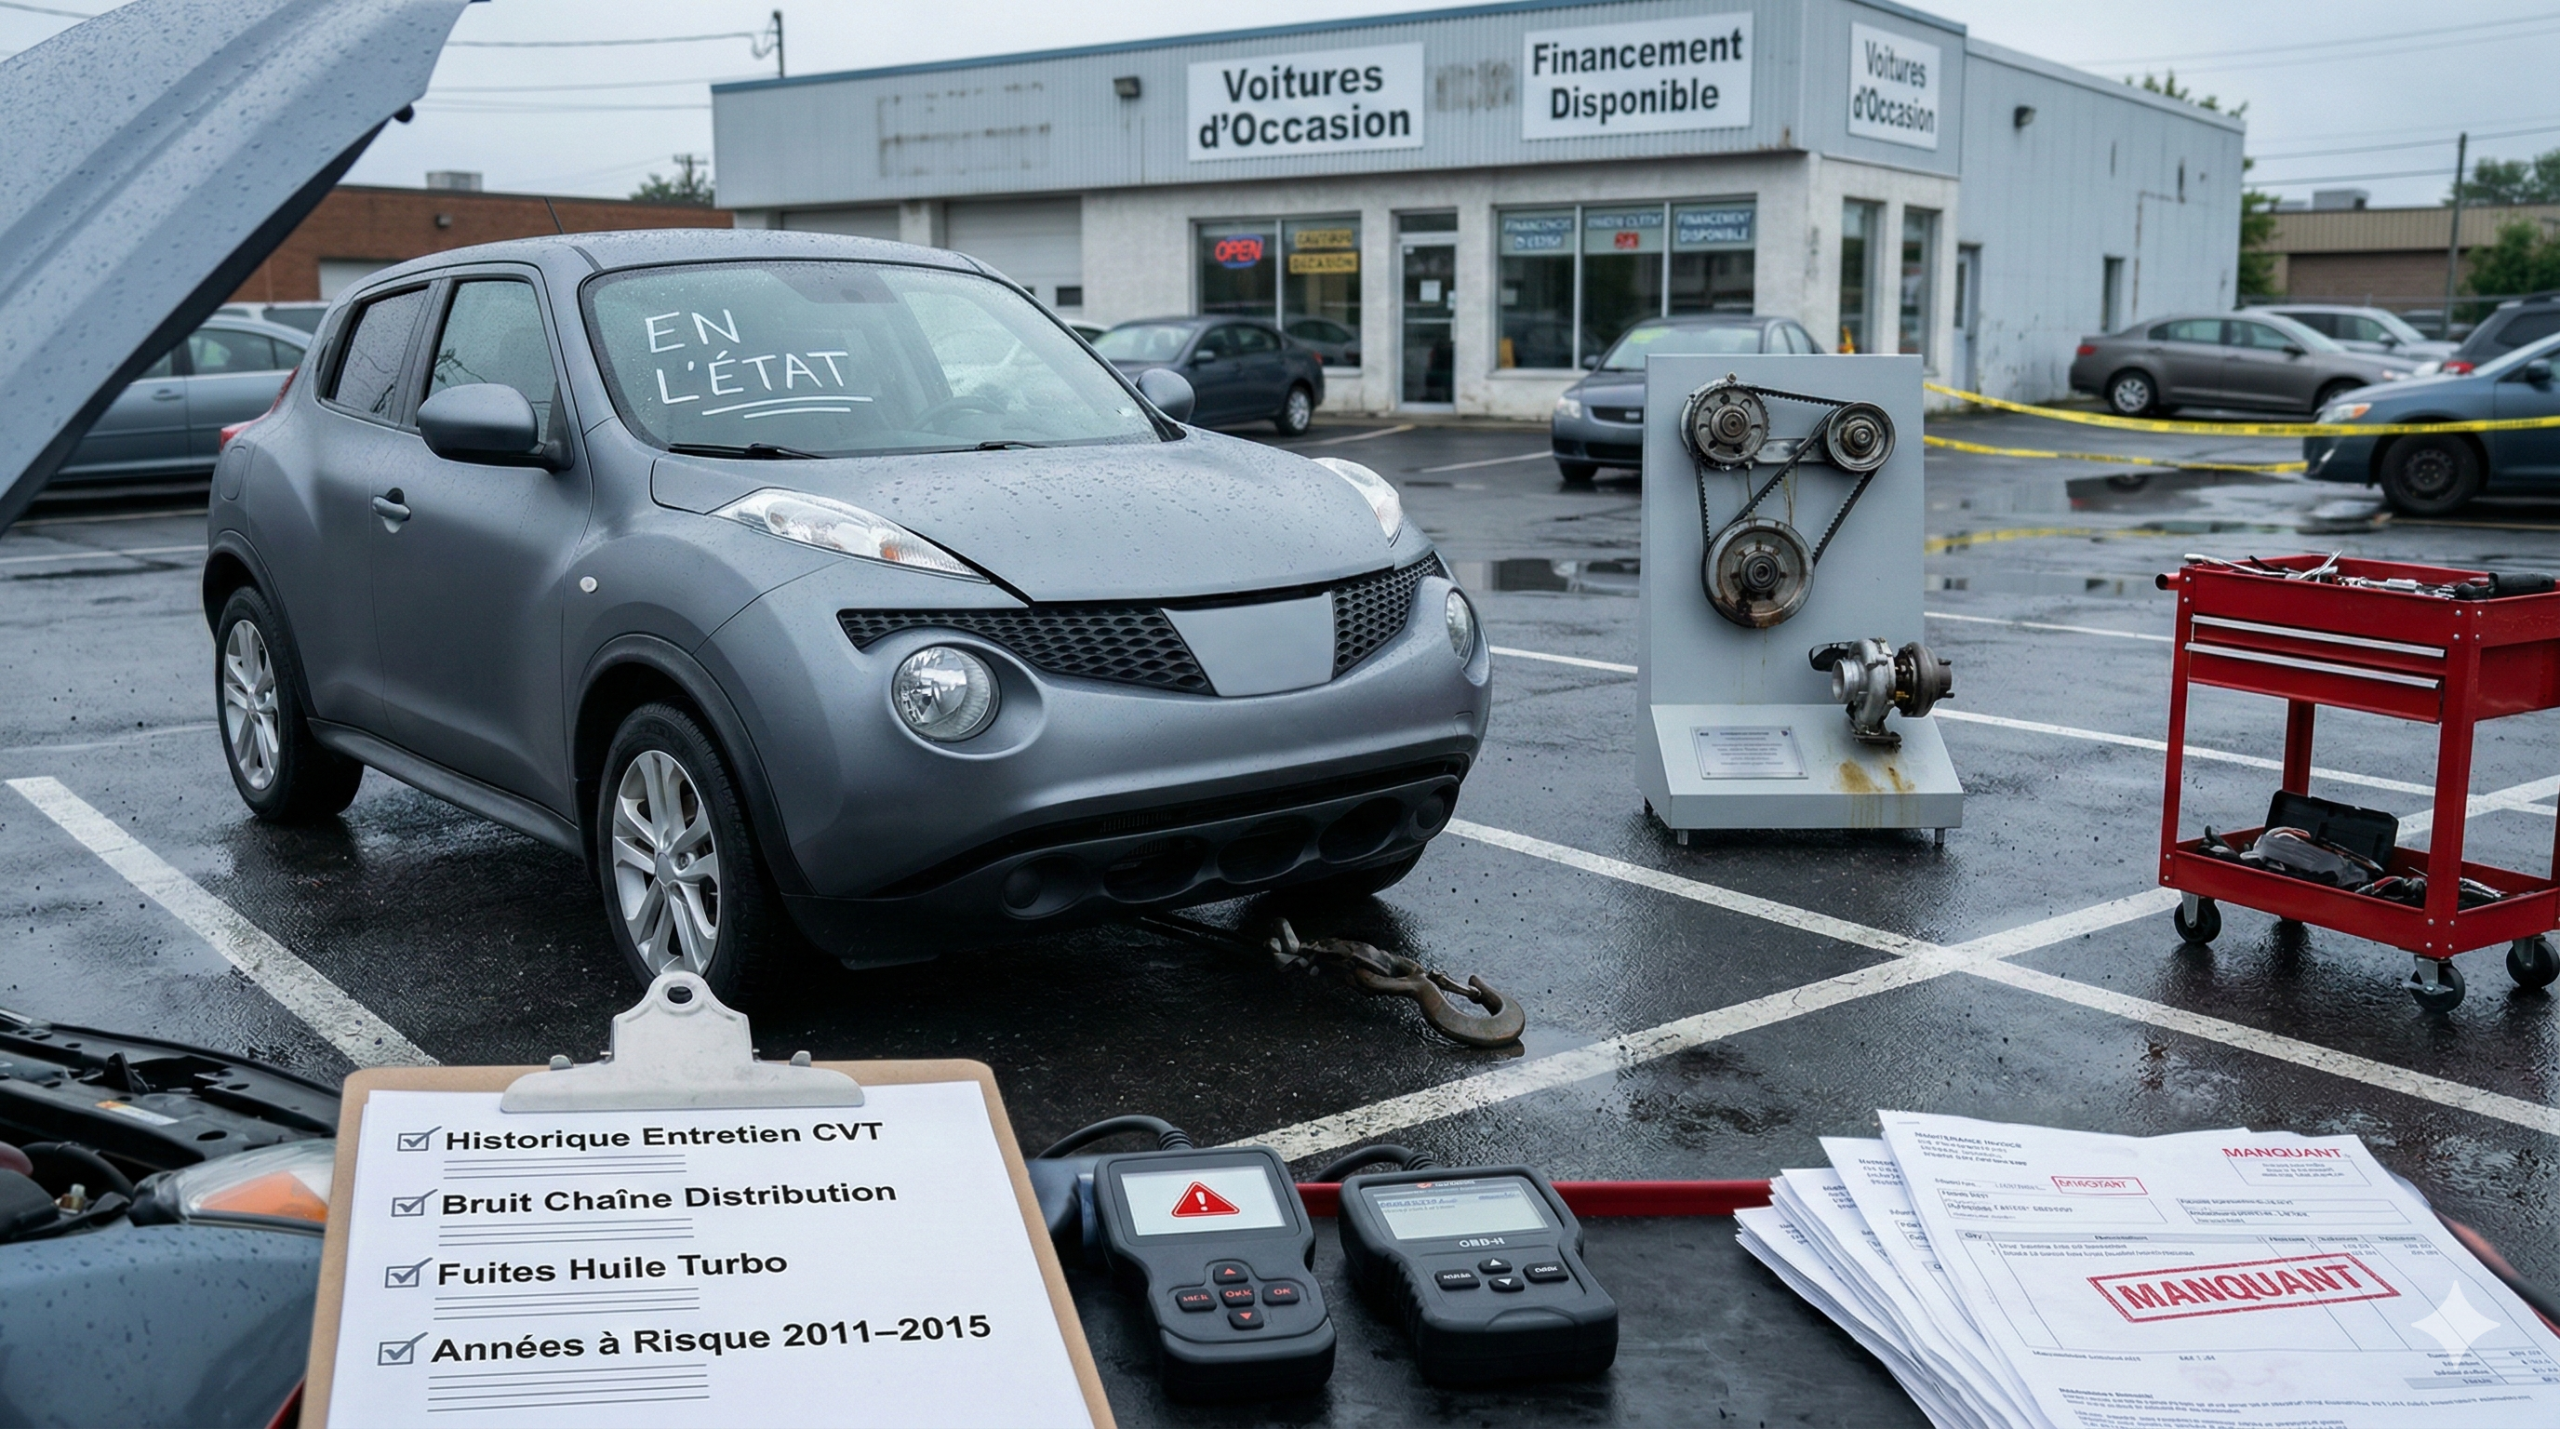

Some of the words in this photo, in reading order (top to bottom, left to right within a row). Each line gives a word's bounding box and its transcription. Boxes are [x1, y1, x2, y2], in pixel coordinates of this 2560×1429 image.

[1533, 26, 1743, 76] Financement
[1864, 40, 1927, 89] Voitures
[1223, 65, 1384, 103] Voitures
[1551, 77, 1720, 126] Disponible
[1199, 104, 1411, 149] d’Occasion
[1214, 239, 1262, 262] OPEN
[645, 309, 741, 354] EN
[656, 350, 849, 405] L'ÉTAT
[445, 1130, 631, 1152] Historique
[642, 1125, 802, 1147] Entretien
[812, 1122, 884, 1142] CVT
[2222, 1148, 2343, 1158] MANQUANT
[442, 1192, 533, 1216] Bruit
[544, 1188, 673, 1212] Chaîne
[685, 1183, 897, 1208] Distribution
[438, 1261, 557, 1286] Fuites
[570, 1256, 667, 1281] Huile
[677, 1252, 788, 1277] Turbo
[2115, 1264, 2363, 1309] MANQUANT
[430, 1334, 585, 1363] Années
[599, 1332, 621, 1356] à
[633, 1329, 771, 1356] Risque
